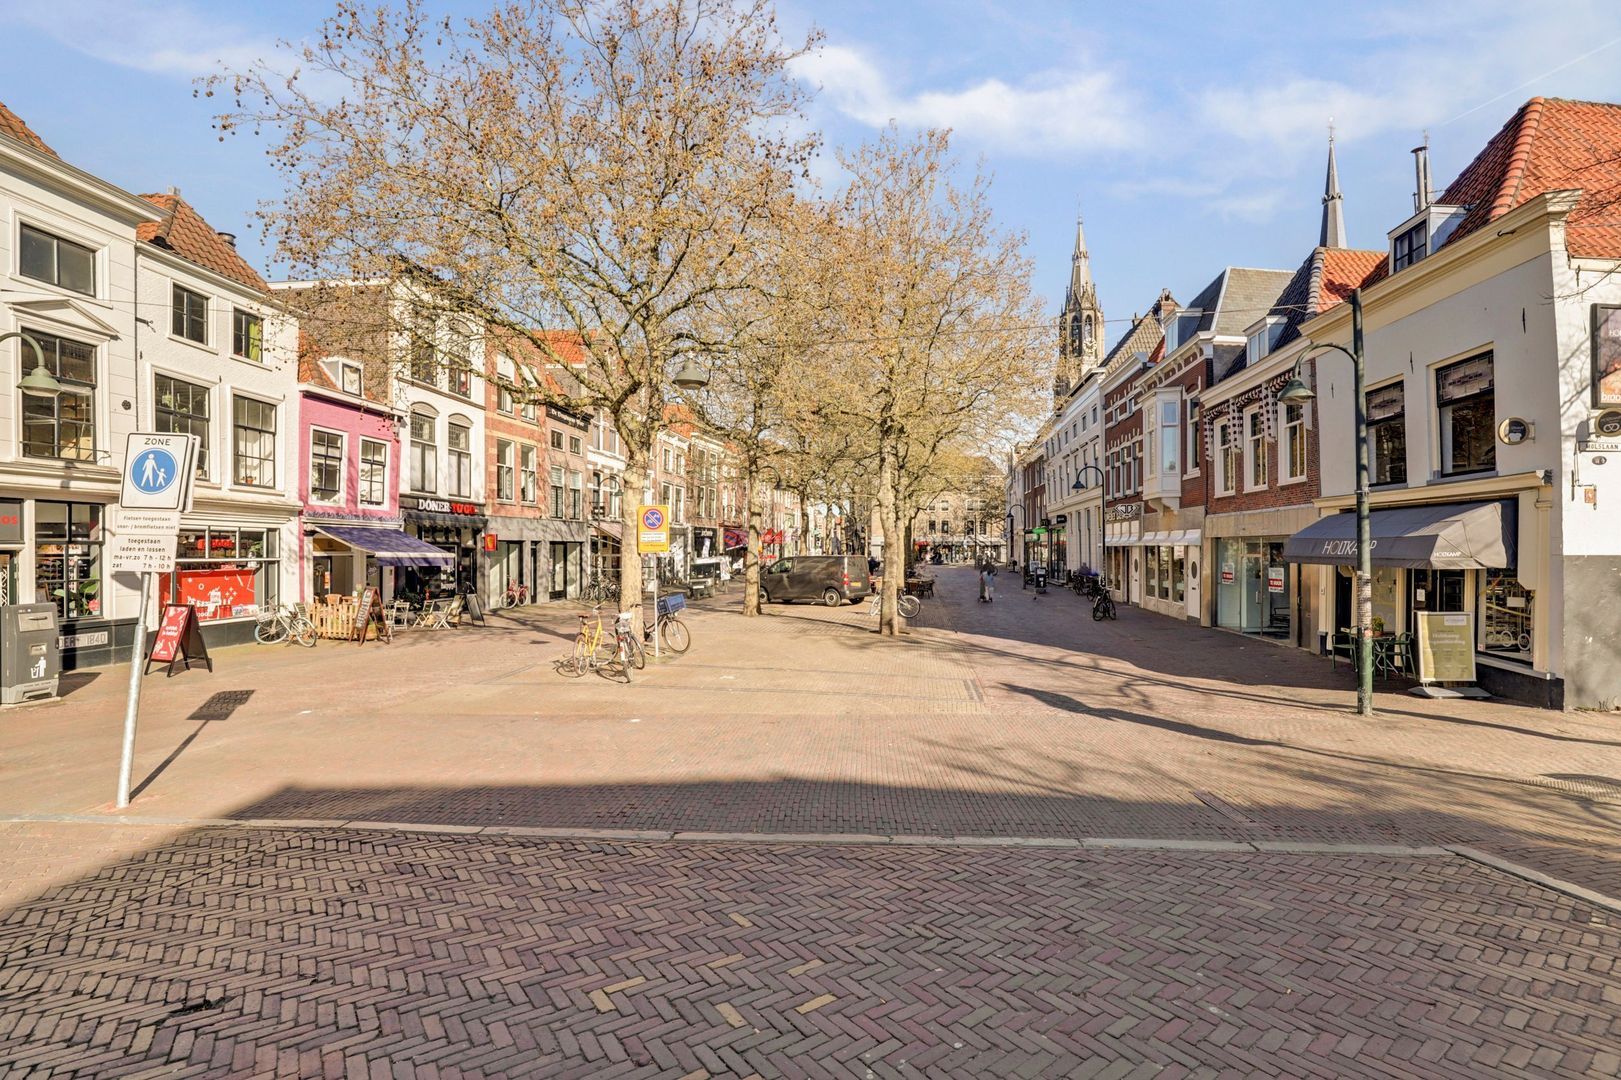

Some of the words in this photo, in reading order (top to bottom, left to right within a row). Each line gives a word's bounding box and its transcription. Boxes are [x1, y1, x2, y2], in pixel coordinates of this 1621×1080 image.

[144, 437, 171, 446] ZONE
[1322, 540, 1377, 555] HOLTKAP
[87, 632, 106, 645] 1840
